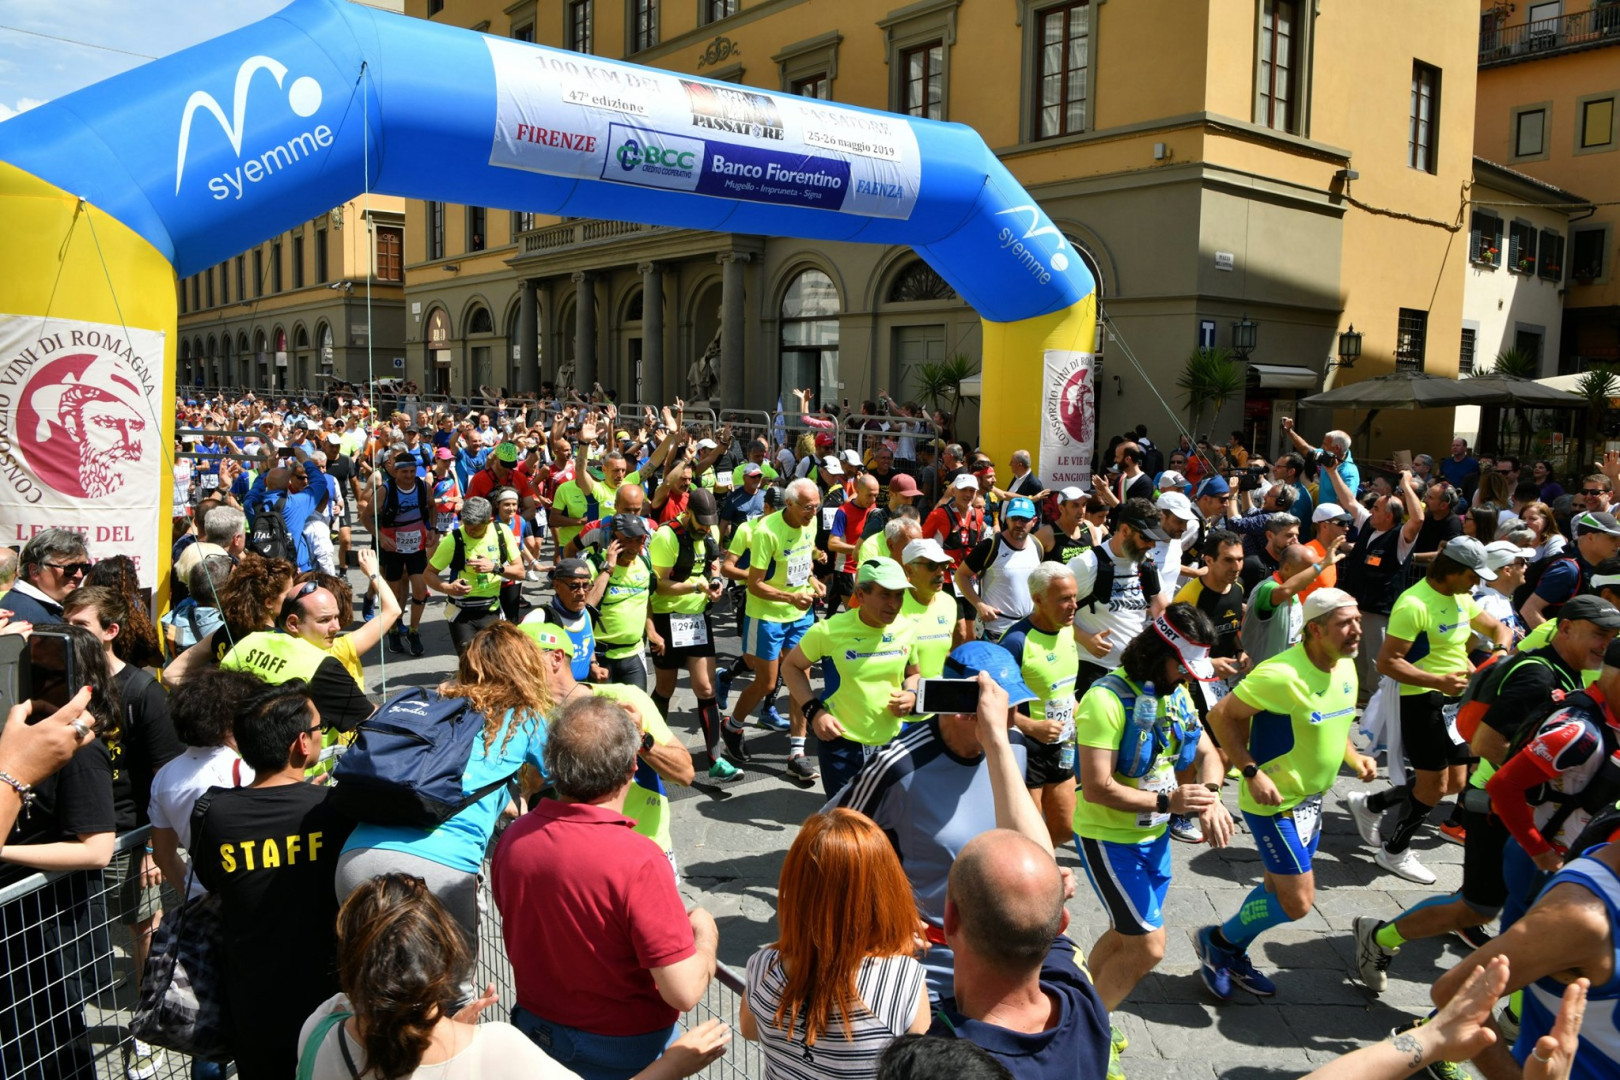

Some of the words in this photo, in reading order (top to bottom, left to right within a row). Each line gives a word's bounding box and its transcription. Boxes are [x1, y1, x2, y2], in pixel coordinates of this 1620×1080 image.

[592, 92, 645, 114] edizione
[516, 123, 597, 153] FIRENZE
[691, 114, 785, 142] PASSATORE
[807, 129, 837, 146] 25-26
[838, 138, 871, 154] maggio
[872, 143, 895, 157] 2019
[207, 124, 334, 201] syemme
[644, 145, 696, 170] BCC
[711, 154, 763, 179] Banco
[765, 162, 842, 190] Fiorentino
[724, 178, 755, 192] Mugello
[760, 183, 798, 197] Impruneta
[803, 188, 822, 200] Signa
[856, 178, 904, 200] FAENZA
[998, 227, 1052, 286] syemme
[37, 332, 65, 356] DI
[71, 330, 156, 398] ROMAGNA
[1069, 358, 1080, 371] DI
[1057, 456, 1070, 466] LE
[1071, 456, 1083, 466] VIE
[95, 525, 135, 543] DEL
[245, 648, 288, 675] STAFF
[219, 830, 324, 874] STAFF
